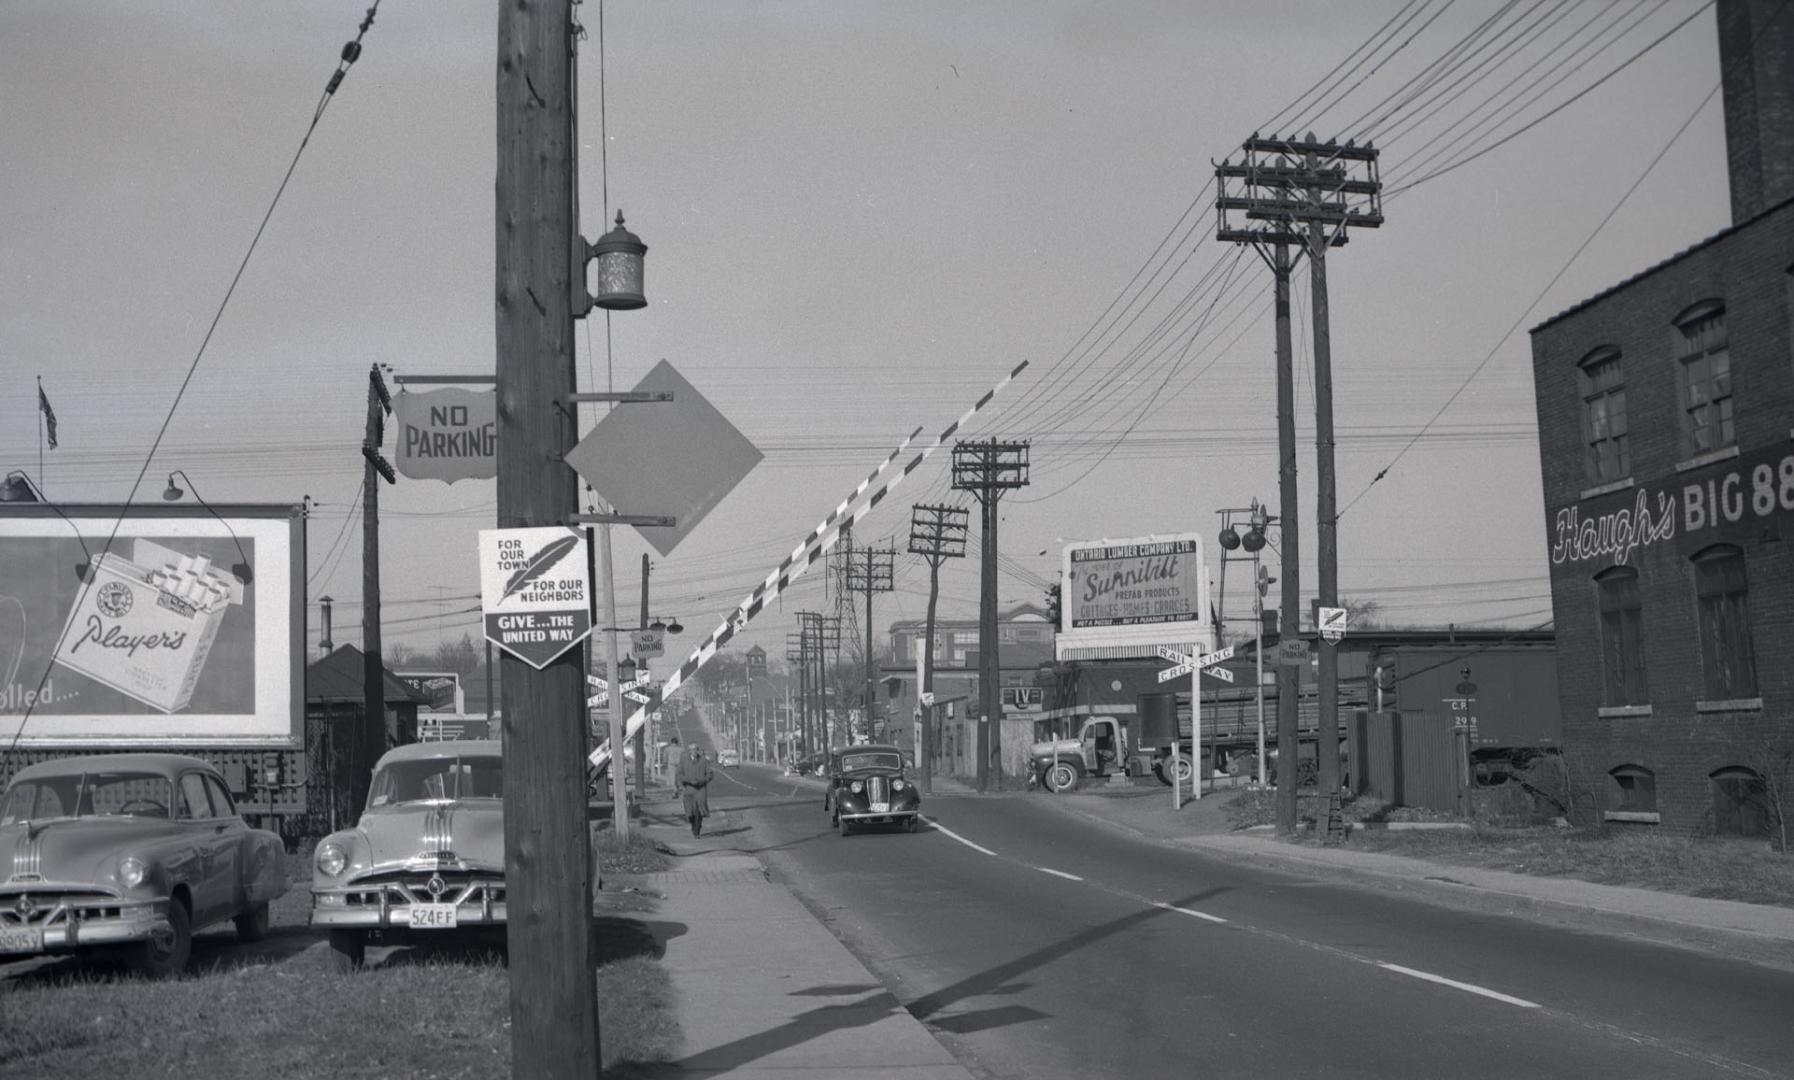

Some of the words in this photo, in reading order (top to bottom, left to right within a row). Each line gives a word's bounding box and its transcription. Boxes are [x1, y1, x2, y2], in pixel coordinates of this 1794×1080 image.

[431, 406, 467, 426] NO
[406, 422, 497, 457] PARKING
[1553, 488, 1675, 565] Haugh's
[1684, 472, 1743, 532] BIG
[498, 540, 521, 549] FOR
[501, 551, 524, 560] OUR
[1075, 548, 1106, 561] ONTARIO
[1108, 545, 1138, 559] LUMBER
[1140, 543, 1174, 556] COMPANY
[497, 561, 529, 570] TOWN
[534, 581, 555, 590] FOR
[559, 580, 583, 590] OUR
[521, 591, 583, 602] NEIGHBORS
[1115, 589, 1142, 600] PREFAB
[1144, 587, 1180, 598] PRODUCTS
[71, 614, 187, 658] Player's
[503, 630, 546, 643] UNITED
[549, 629, 574, 641] WAY
[642, 634, 654, 642] NO
